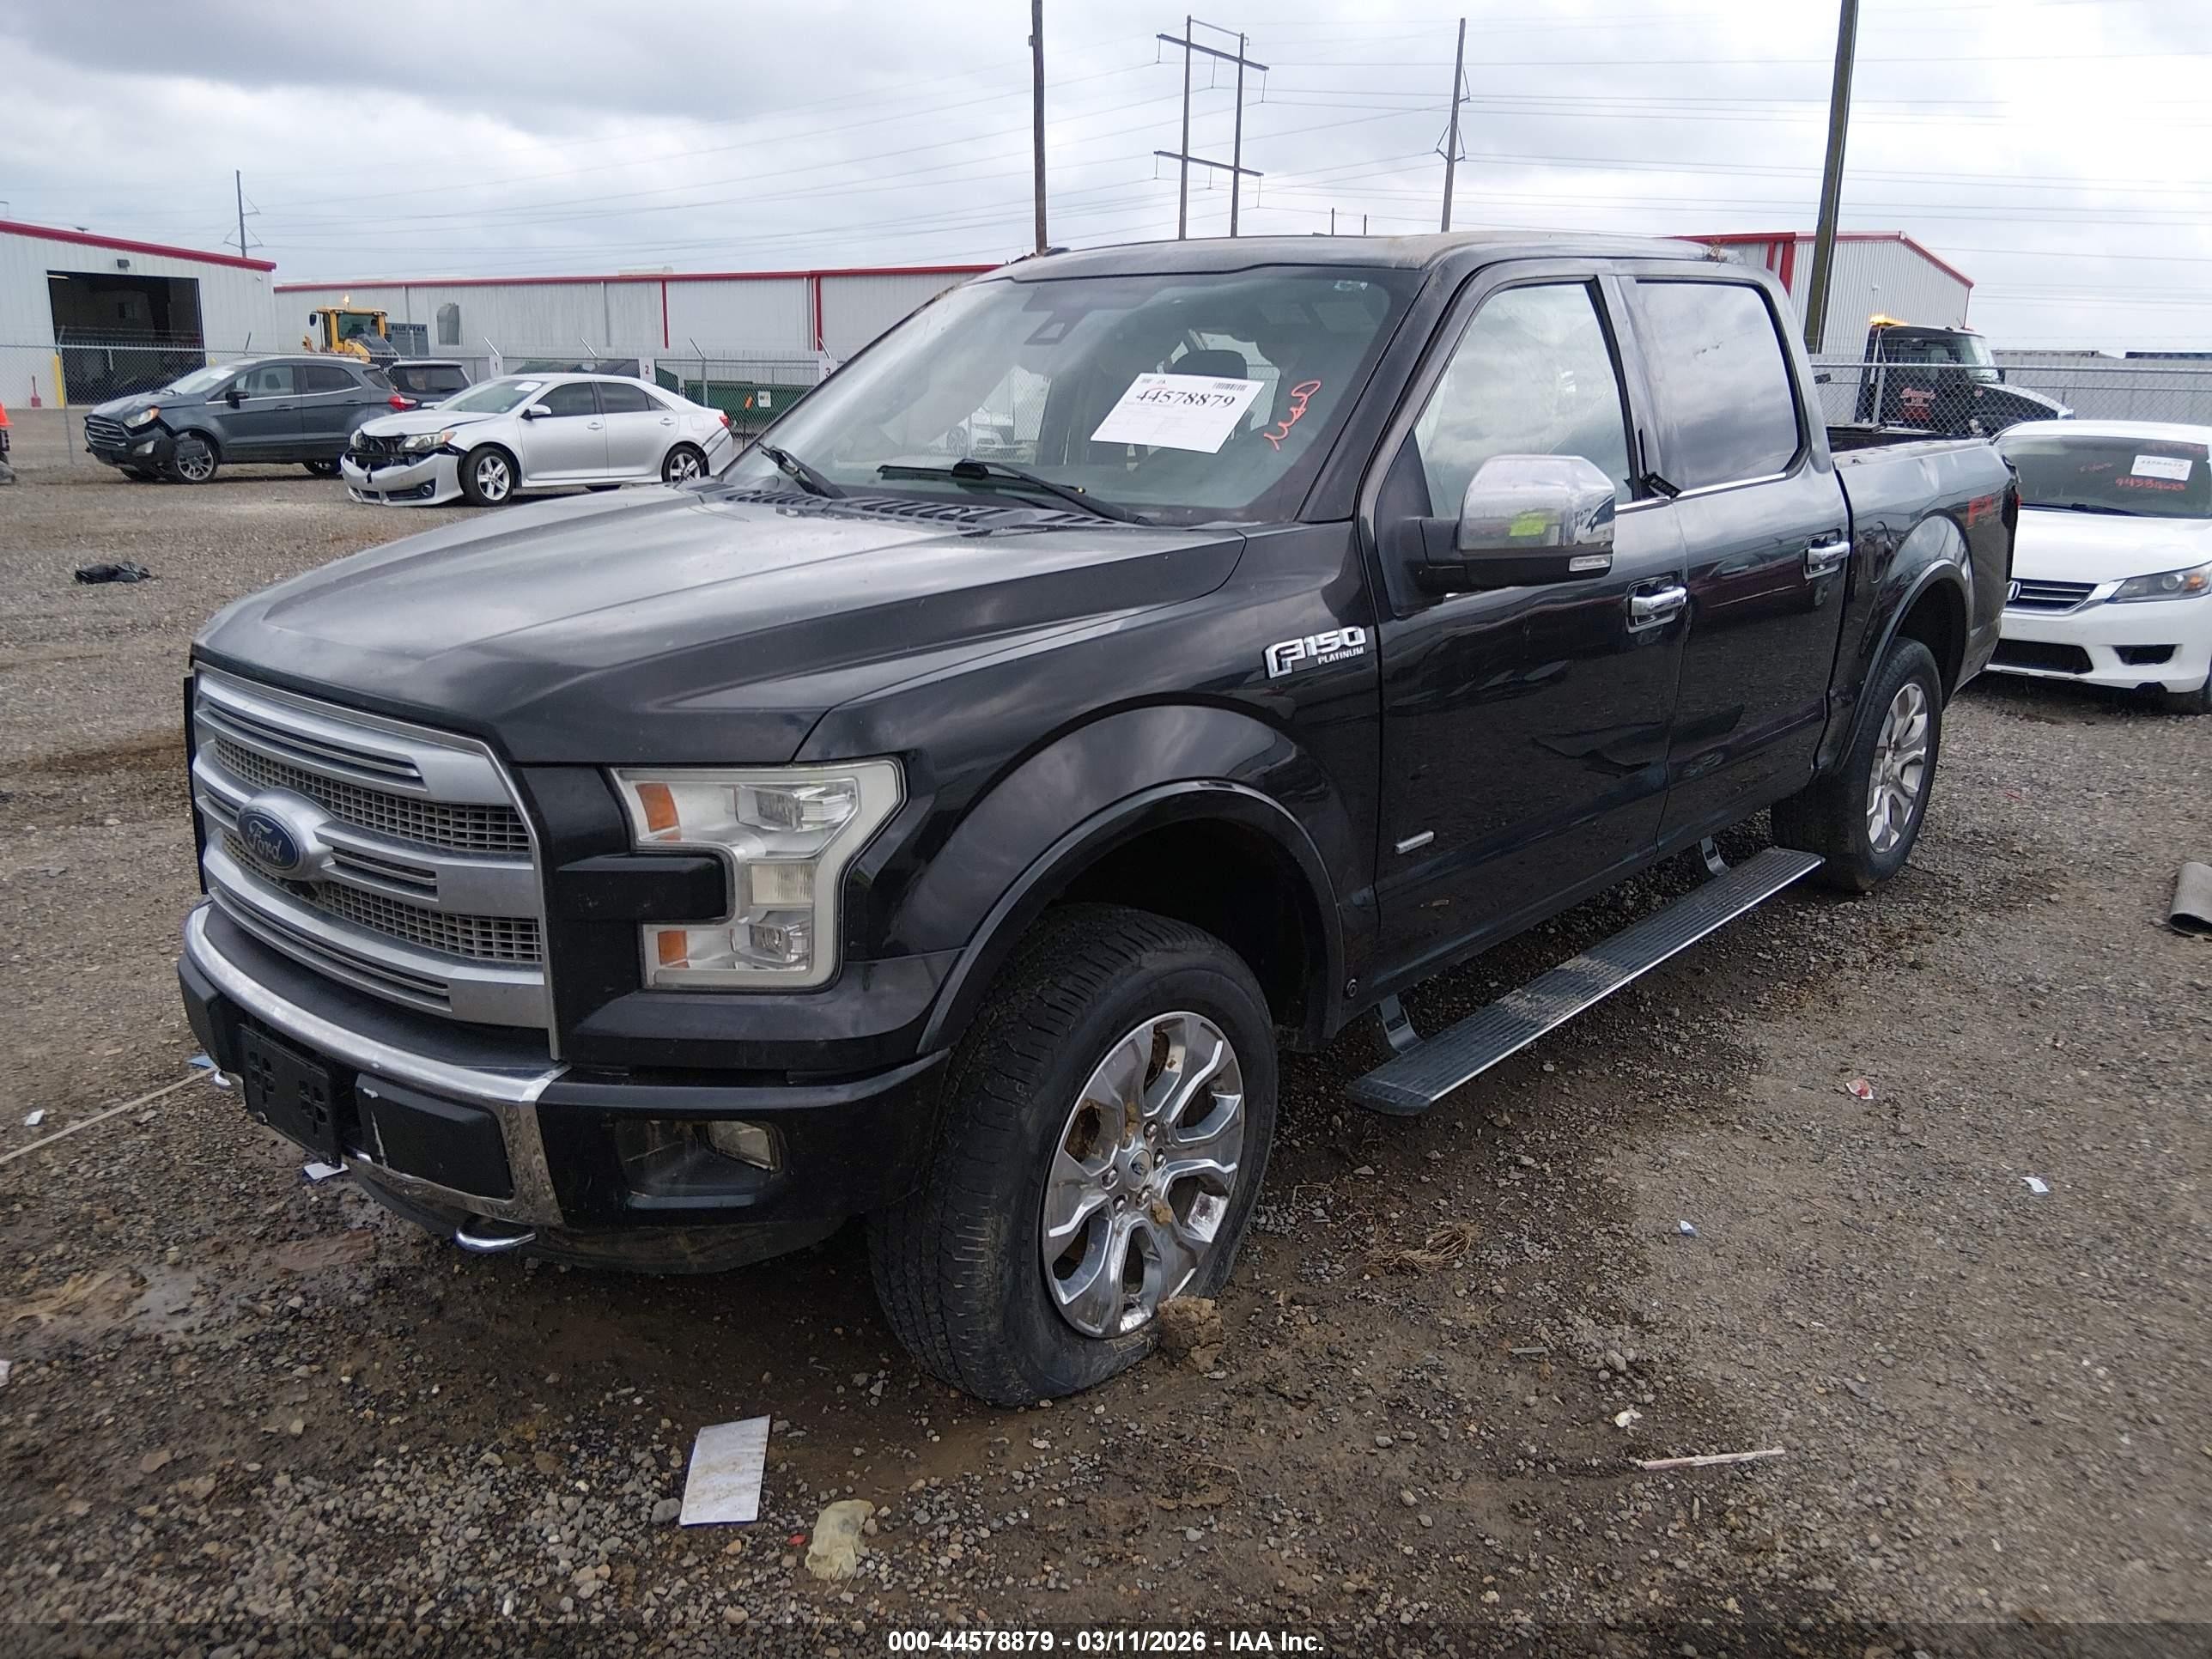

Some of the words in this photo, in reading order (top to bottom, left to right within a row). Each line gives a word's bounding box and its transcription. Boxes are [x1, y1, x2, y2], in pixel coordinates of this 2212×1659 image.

[645, 365, 650, 374] 2
[825, 368, 831, 378] 3
[1137, 388, 1237, 409] 44578879
[1317, 647, 1364, 666] PLATINUM
[247, 819, 283, 863] Ford
